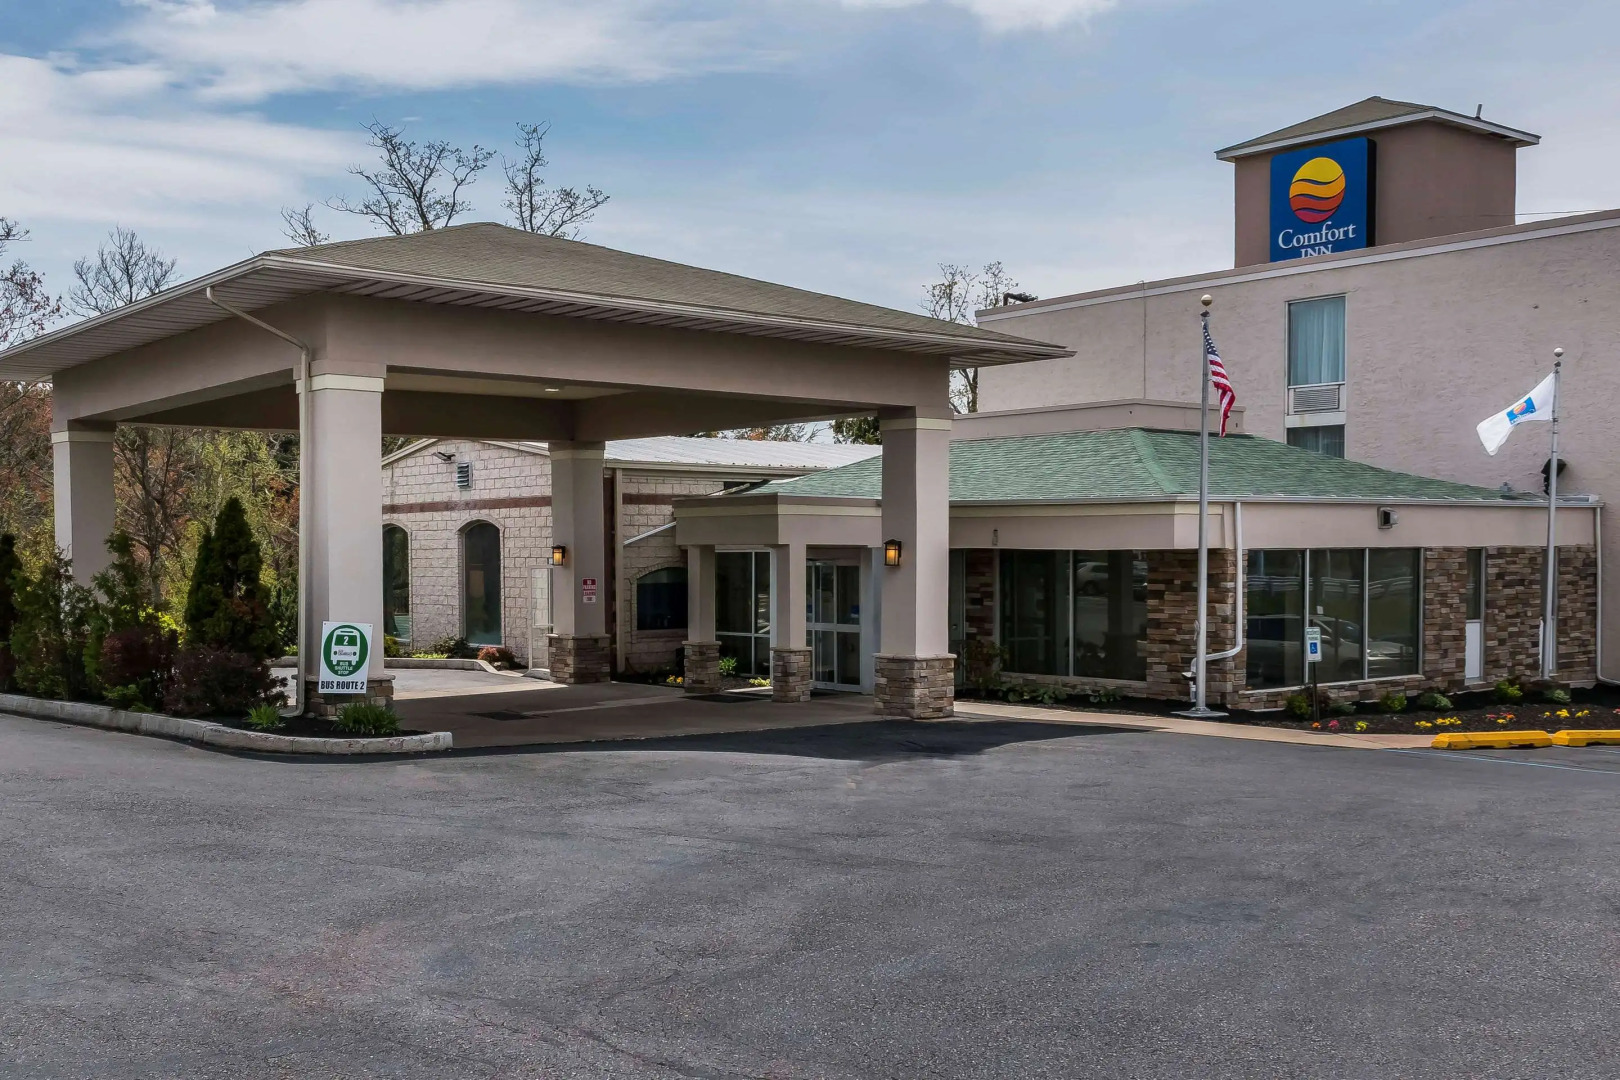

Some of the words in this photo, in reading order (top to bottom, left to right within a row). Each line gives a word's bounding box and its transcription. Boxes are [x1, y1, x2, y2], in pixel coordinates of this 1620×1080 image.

[1278, 221, 1356, 249] Comfort
[1300, 244, 1332, 259] INN
[343, 636, 349, 645] 2
[320, 680, 335, 690] BUS
[336, 681, 359, 690] ROUTE
[360, 681, 365, 690] 2
